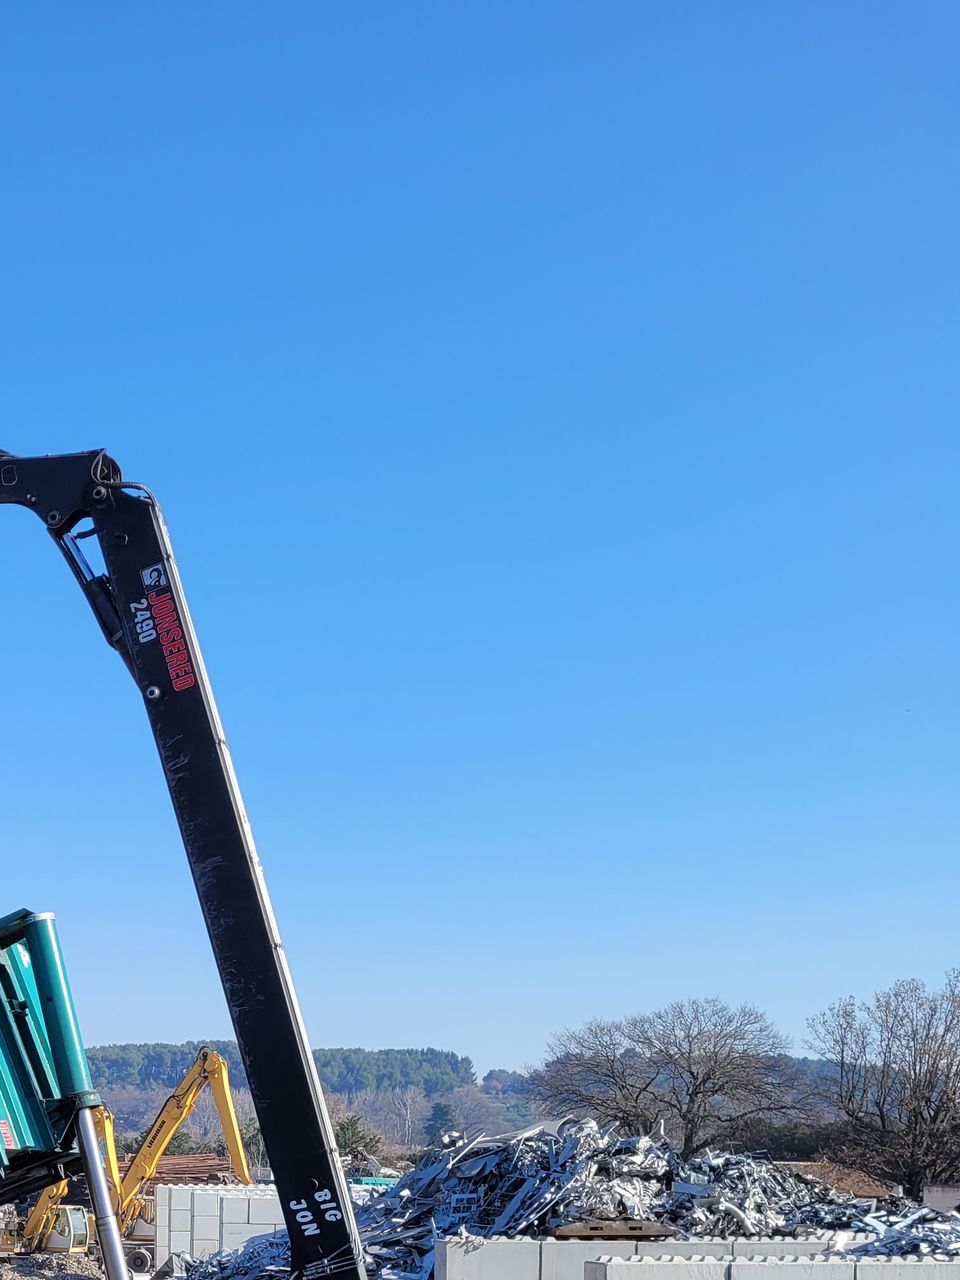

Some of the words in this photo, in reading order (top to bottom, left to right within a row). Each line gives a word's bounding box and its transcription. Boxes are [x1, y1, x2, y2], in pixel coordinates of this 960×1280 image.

[129, 598, 157, 643] 2490
[147, 592, 195, 692] JONSERED
[289, 1198, 321, 1237] JON
[314, 1188, 342, 1221] BIG
